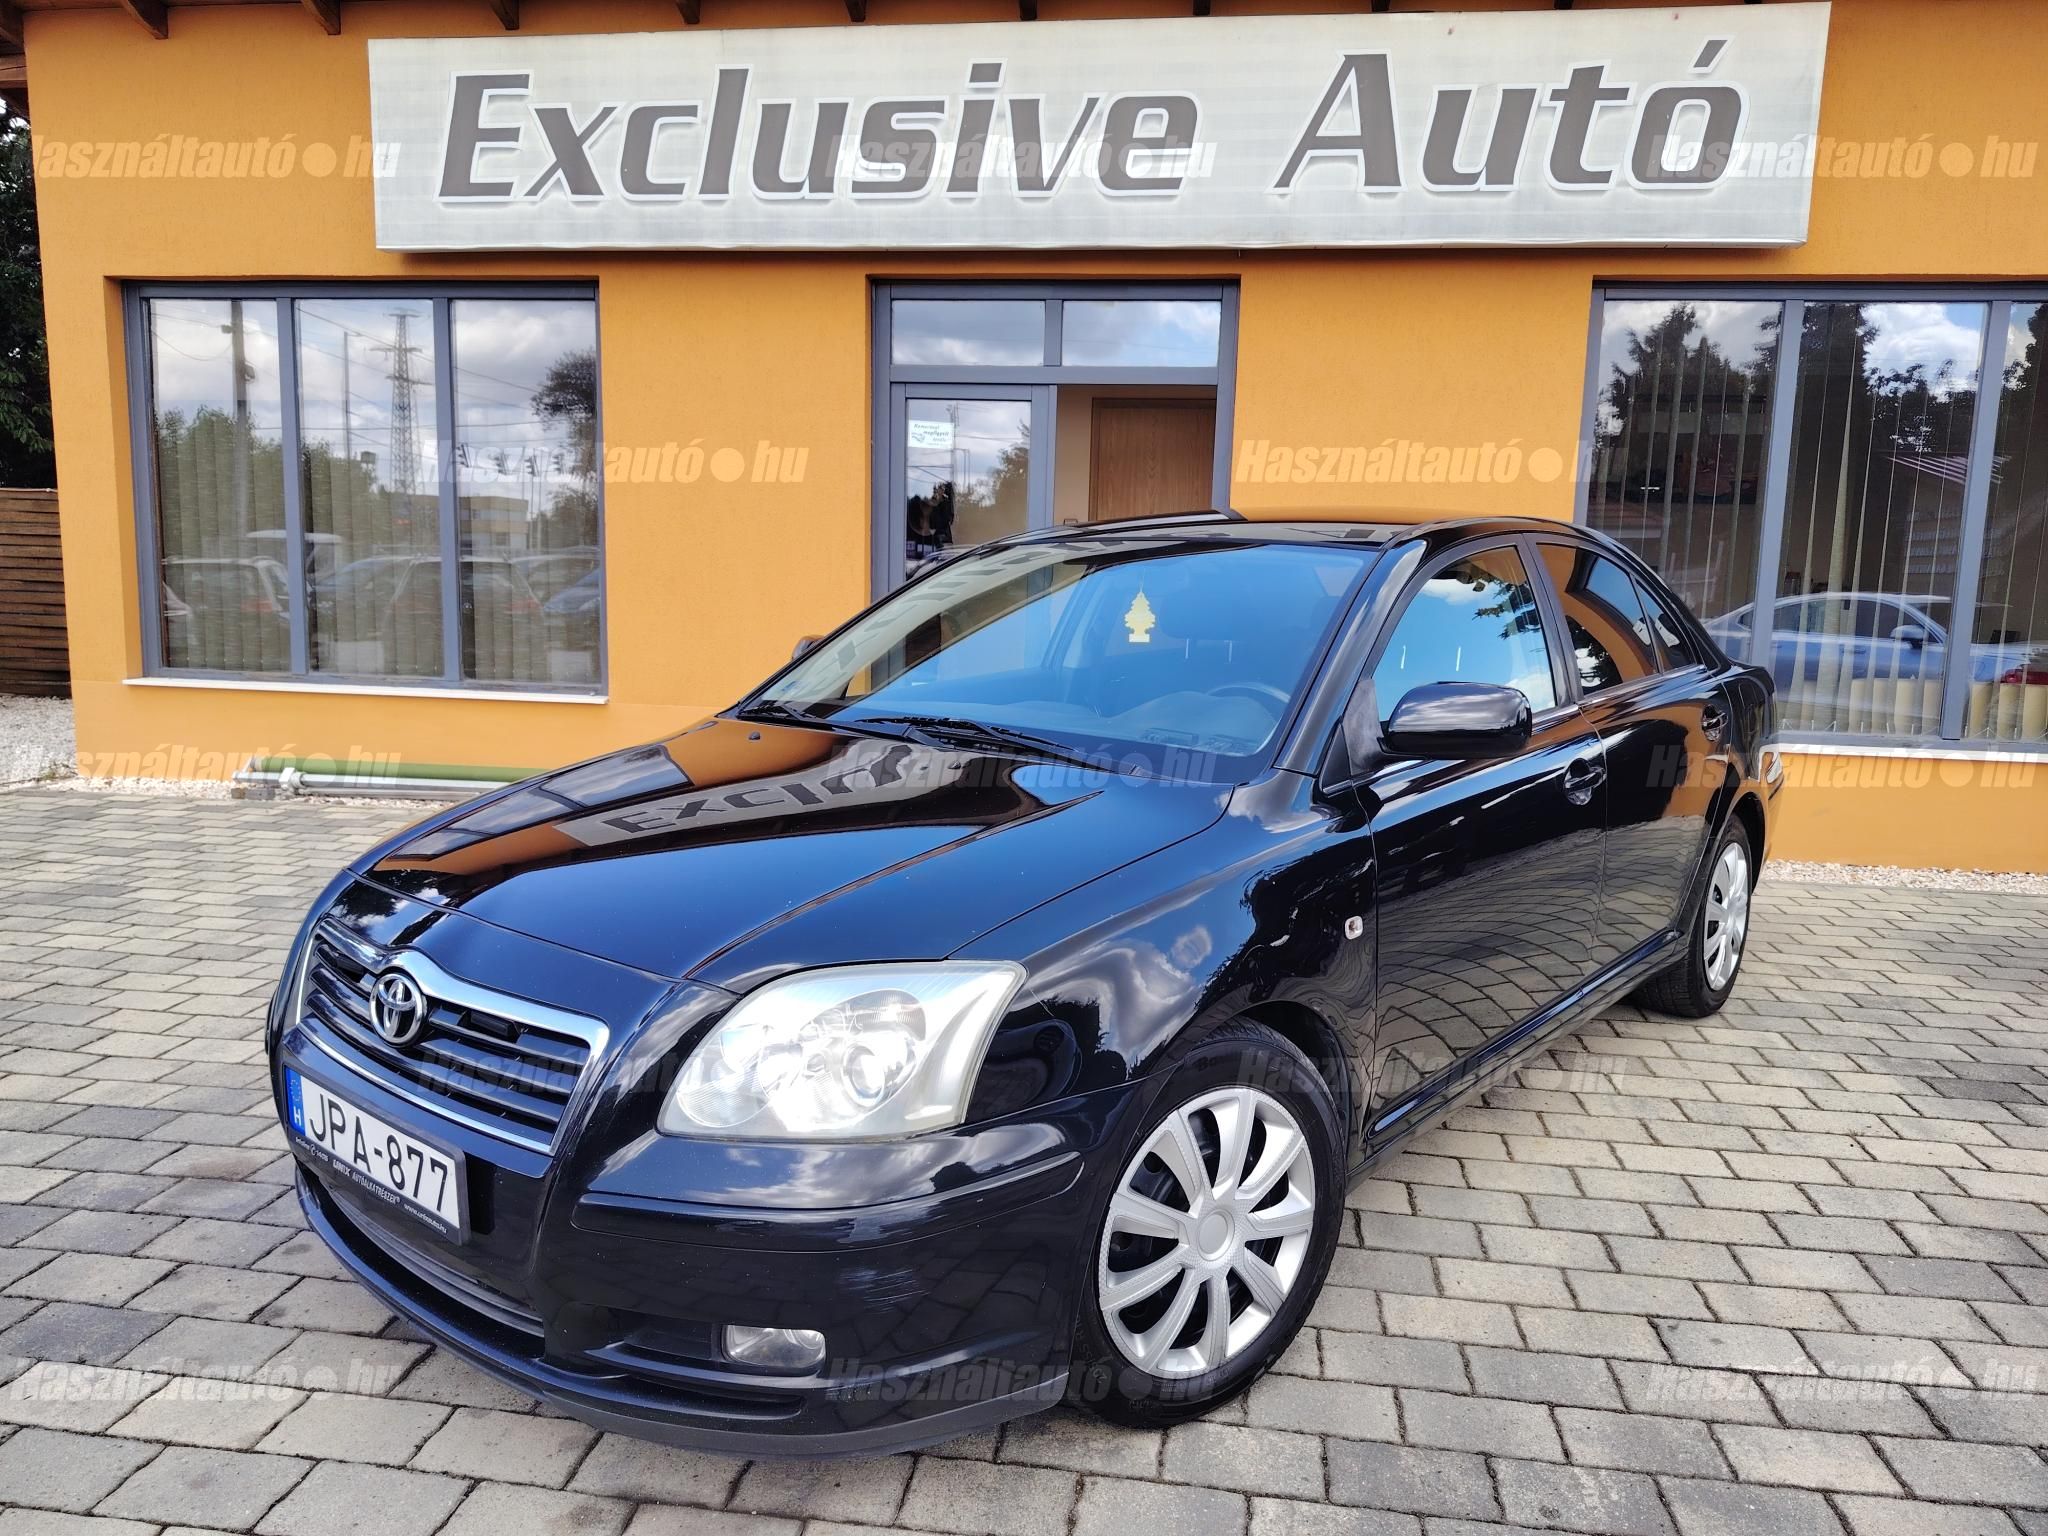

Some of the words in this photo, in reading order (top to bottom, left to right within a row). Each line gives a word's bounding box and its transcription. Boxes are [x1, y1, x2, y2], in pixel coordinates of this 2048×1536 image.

[434, 58, 1200, 201] Exclusive
[1265, 36, 1750, 194] Autó
[309, 1093, 448, 1212] JPA-877
